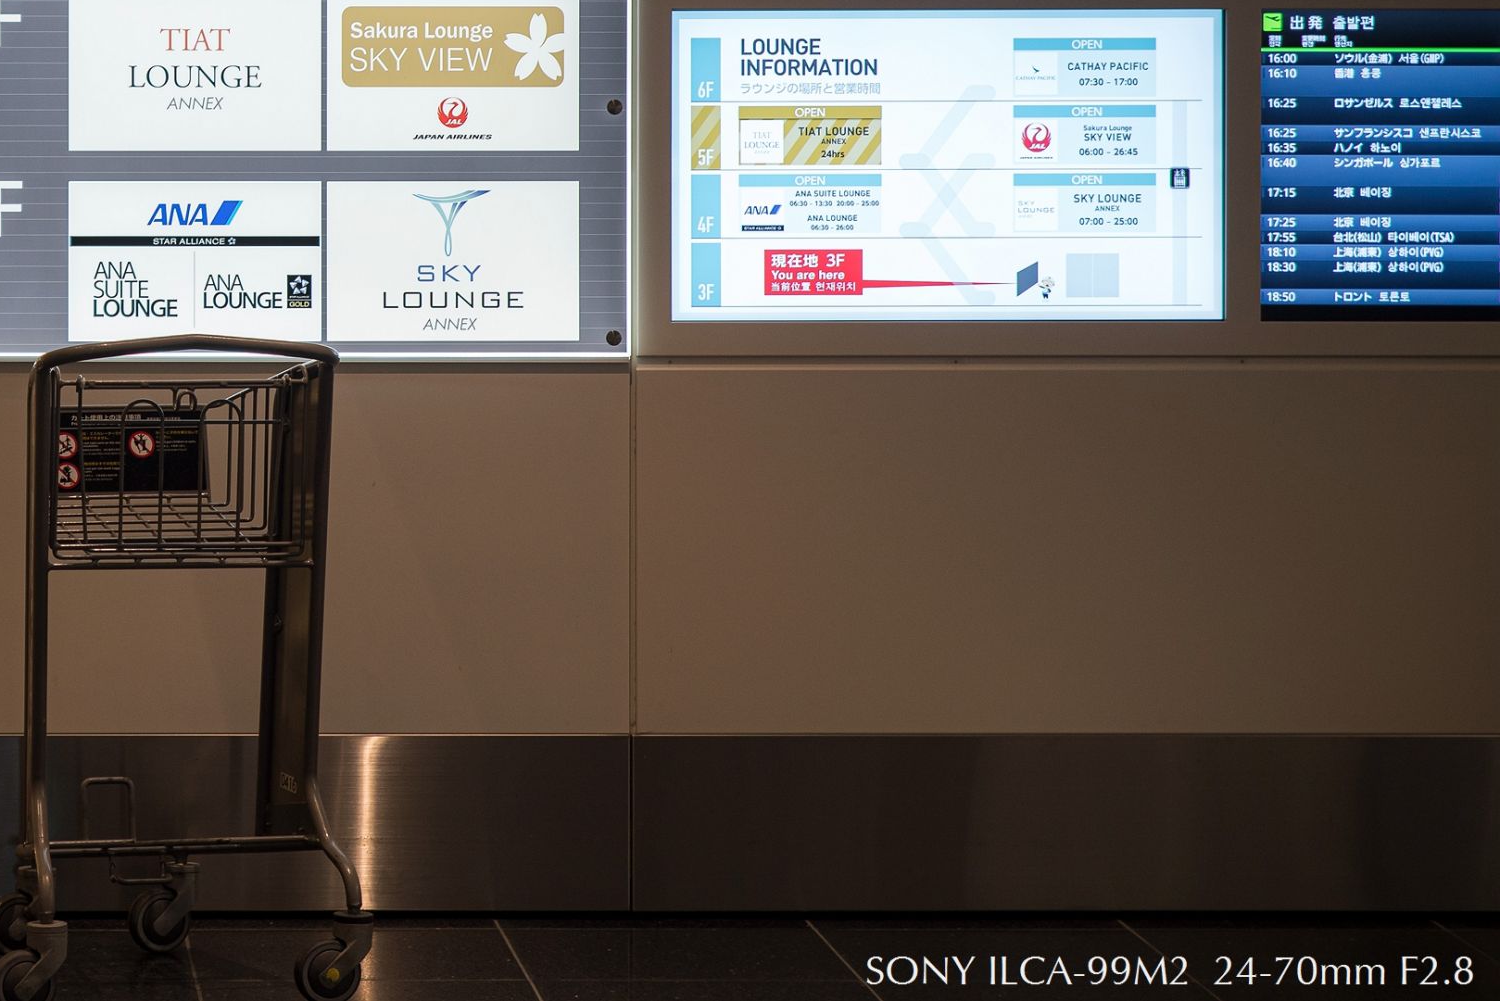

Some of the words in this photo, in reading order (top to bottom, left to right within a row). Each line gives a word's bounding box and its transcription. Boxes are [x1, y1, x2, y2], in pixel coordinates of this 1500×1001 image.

[1290, 16, 1322, 30] 出発
[1333, 16, 1374, 30] 출발편
[350, 22, 418, 39] Sakura
[425, 22, 493, 42] Lounge
[159, 28, 231, 52] TIAT
[1071, 40, 1103, 49] OPEN
[741, 39, 821, 55] LOUNGE
[350, 48, 408, 72] SKY
[418, 48, 493, 72] VIEW
[1268, 54, 1297, 63] 16:00
[741, 59, 878, 76] INFORMATION
[1067, 62, 1107, 71] CATHAY
[1110, 62, 1149, 71] PACIFIC
[128, 65, 262, 89] LOUNGE
[1268, 69, 1297, 78] 16:10
[1079, 78, 1104, 86] 07:30
[1114, 78, 1138, 86] 17:00
[698, 81, 714, 98] 6F
[741, 83, 880, 94] ラウンジの場所と営業時間
[166, 97, 224, 111] ANNEX
[1268, 99, 1296, 108] 16:25
[1334, 98, 1393, 108] ロサンゼルス
[1399, 98, 1462, 108] 로스앤젤레스
[795, 107, 826, 117] OPEN
[1071, 107, 1103, 117] OPEN
[798, 127, 822, 136] TIAT
[826, 127, 869, 136] LOUNGE
[1268, 128, 1296, 138] 16:25
[1334, 128, 1412, 138] サンフランシスコ
[1084, 133, 1102, 141] SKY
[1107, 133, 1131, 141] VIEW
[1079, 148, 1104, 156] 06:00
[1114, 148, 1138, 156] 26:45
[1268, 143, 1296, 153] 16:35
[1334, 143, 1363, 153] ハノイ
[1371, 143, 1401, 153] 하노이
[698, 149, 714, 165] 5F
[821, 150, 845, 158] 24hrs
[1268, 158, 1296, 168] 16:40
[1334, 158, 1393, 168] シンガポール
[795, 176, 826, 185] OPEN
[1071, 175, 1103, 184] OPEN
[1268, 188, 1296, 197] 17:15
[1073, 194, 1095, 203] SKY
[1098, 194, 1142, 203] LOUNGE
[147, 203, 208, 225] ANA
[744, 205, 769, 215] ANA
[697, 216, 714, 232] 4F
[1267, 218, 1296, 227] 17:25
[1267, 233, 1296, 242] 17:55
[1267, 248, 1295, 257] 18:10
[771, 254, 818, 268] 現在地
[826, 254, 845, 267] 3F
[94, 261, 136, 279] ANA
[1267, 263, 1295, 272] 18:30
[417, 264, 482, 282] SKY
[772, 270, 793, 280] You
[796, 272, 815, 280] are
[819, 270, 845, 280] here
[204, 274, 244, 291] ANA
[771, 282, 810, 292] 当前位置
[815, 282, 856, 292] 현재위치
[94, 280, 148, 298] SUITE
[698, 284, 714, 300] 3F
[203, 292, 282, 309] LOUNGE
[382, 291, 524, 309] LOUNGE
[1267, 292, 1295, 302] 18:50
[1334, 292, 1372, 302] トロント
[94, 299, 178, 317] LOUNGE
[422, 318, 477, 331] ANNEX
